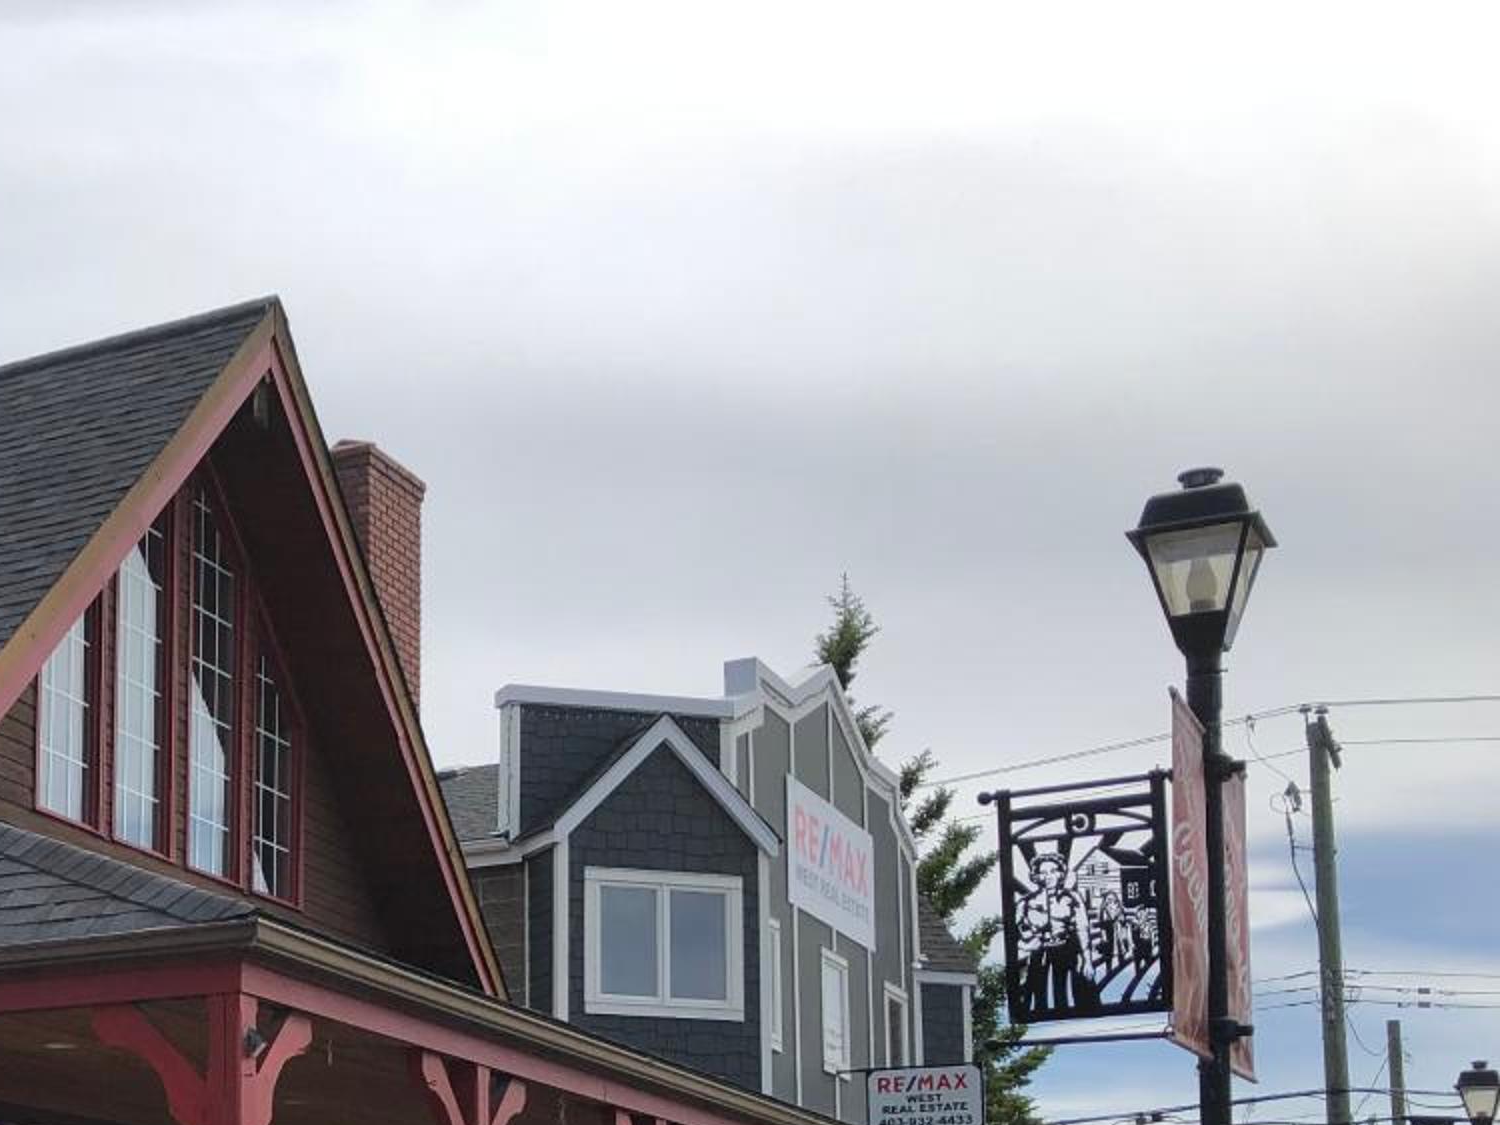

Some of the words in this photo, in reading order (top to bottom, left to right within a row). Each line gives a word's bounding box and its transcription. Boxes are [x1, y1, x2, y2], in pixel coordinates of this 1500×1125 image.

[795, 805, 868, 896] RE/MAX
[878, 1073, 968, 1093] RE/MAX
[882, 1105, 916, 1114] REAL
[919, 1101, 968, 1112] ESTATE
